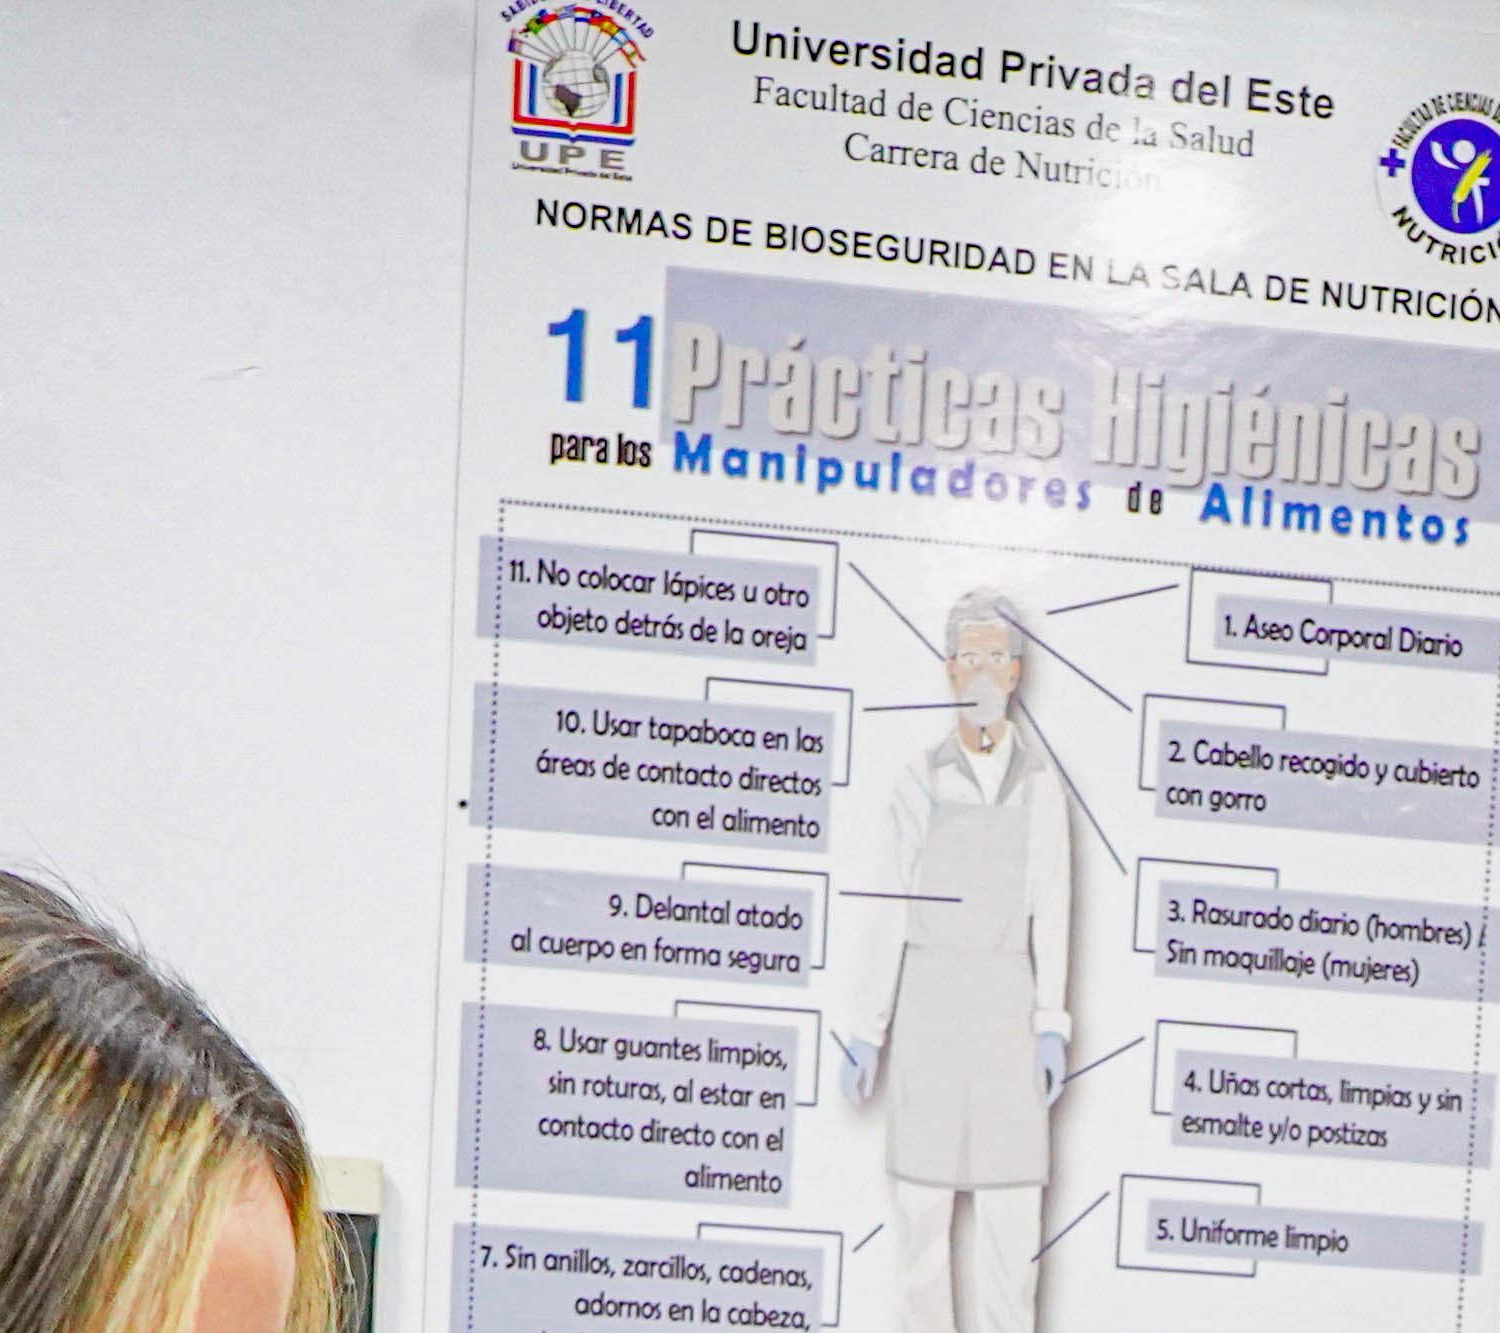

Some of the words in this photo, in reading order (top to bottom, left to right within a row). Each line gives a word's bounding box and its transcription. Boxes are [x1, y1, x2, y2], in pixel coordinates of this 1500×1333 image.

[733, 19, 984, 81] Universidad
[1000, 49, 1154, 99] Privada
[1171, 70, 1231, 108] del
[1247, 77, 1335, 120] Este
[753, 75, 887, 118] Facultad
[897, 91, 934, 123] de
[943, 96, 1076, 138] Ciencias
[1085, 112, 1121, 143] de
[1170, 121, 1254, 158] Salud
[520, 140, 625, 171] UPE
[843, 132, 959, 172] Carrera
[969, 145, 1006, 177] de
[536, 198, 693, 241] NORMAS
[706, 216, 753, 247] DE
[765, 222, 1036, 276] BIOSEGURIDAD
[1049, 252, 1093, 281] EN
[1106, 262, 1149, 288] LA
[1164, 264, 1252, 299] SALA
[1265, 274, 1310, 305] DE
[548, 307, 653, 409] 11
[668, 323, 1063, 459] Prácticas
[1094, 364, 1482, 499] Higiénicas
[550, 432, 610, 465] para
[616, 432, 653, 469] los
[671, 430, 1092, 510] Manipuladores
[1127, 481, 1163, 516] de
[1198, 480, 1471, 547] Alimentos
[509, 559, 531, 584] 11.
[537, 558, 571, 588] No
[576, 564, 657, 595] colocar
[663, 570, 736, 604] lápices
[743, 585, 758, 604] u
[763, 582, 810, 609] otro
[537, 602, 609, 636] objeto
[614, 609, 685, 641] detrás
[689, 616, 718, 644] de
[724, 618, 745, 646] la
[751, 626, 808, 655] oreja
[1225, 614, 1238, 638] 1.
[1242, 613, 1295, 643] Aseo
[1299, 617, 1393, 653] Corporal
[1398, 627, 1464, 659] Diario
[556, 709, 586, 735] 10.
[592, 709, 643, 739] Usar
[648, 715, 756, 749] tapaboca
[762, 731, 789, 751] en
[795, 726, 824, 755] las
[535, 748, 596, 779] áreas
[602, 753, 631, 782] de
[636, 761, 733, 790] contacto
[738, 765, 823, 797] directos
[1193, 739, 1274, 771] Cabello
[1279, 752, 1371, 781] recogido
[1374, 763, 1389, 787] y
[1393, 758, 1481, 790] cubierto
[651, 807, 690, 829] con
[695, 804, 715, 831] el
[721, 806, 821, 840] alimento
[1165, 786, 1203, 807] con
[1208, 790, 1267, 813] gorro
[1156, 1217, 1175, 1241] 5.
[1180, 1216, 1279, 1249] Uniforme
[1284, 1224, 1350, 1257] limpio
